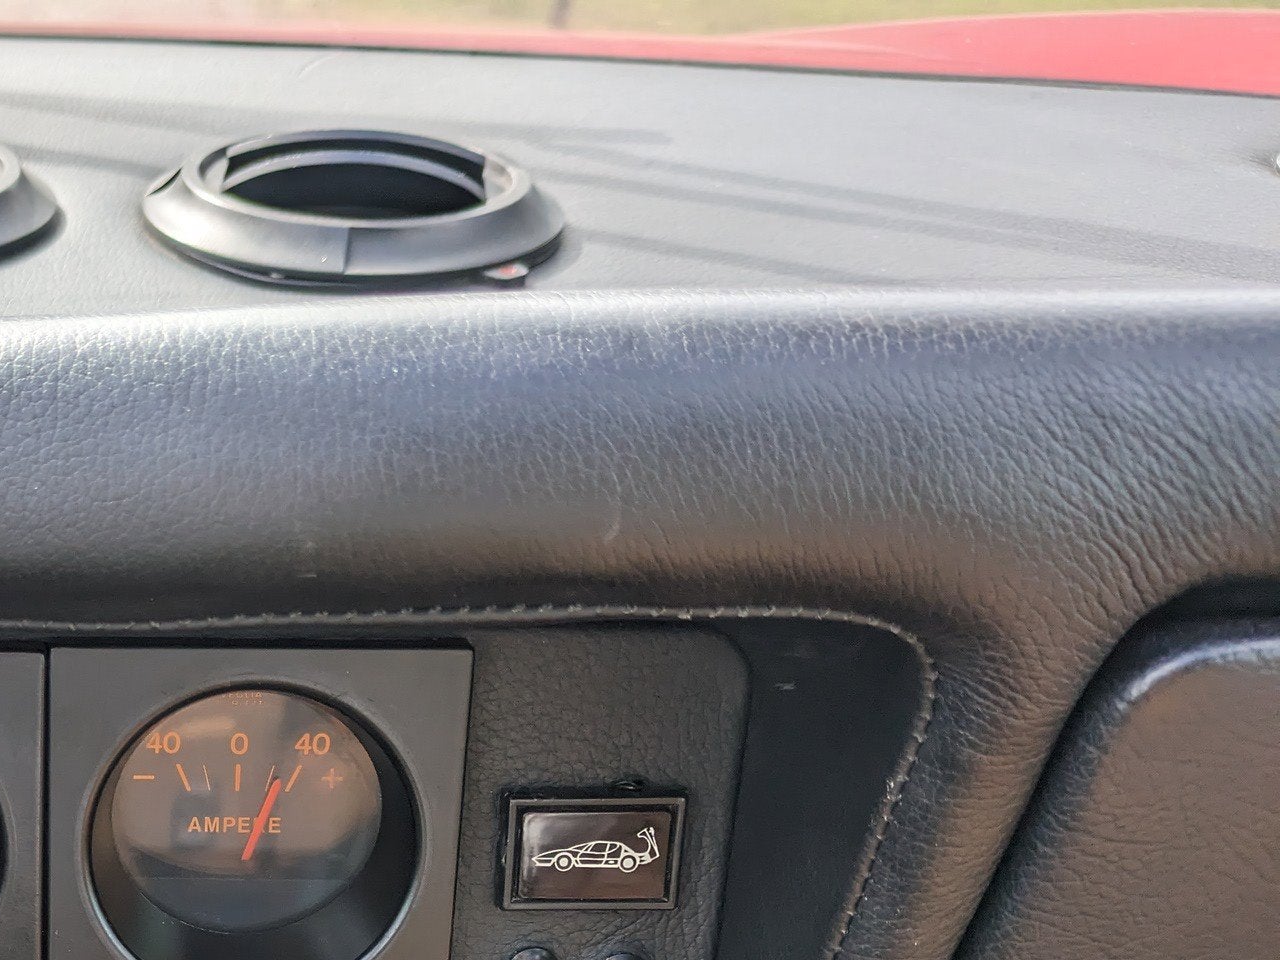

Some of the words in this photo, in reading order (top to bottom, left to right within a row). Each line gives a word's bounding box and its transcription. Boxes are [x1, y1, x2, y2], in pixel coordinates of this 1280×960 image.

[146, 732, 181, 754] 40
[230, 733, 249, 755] 0
[295, 733, 331, 755] 40
